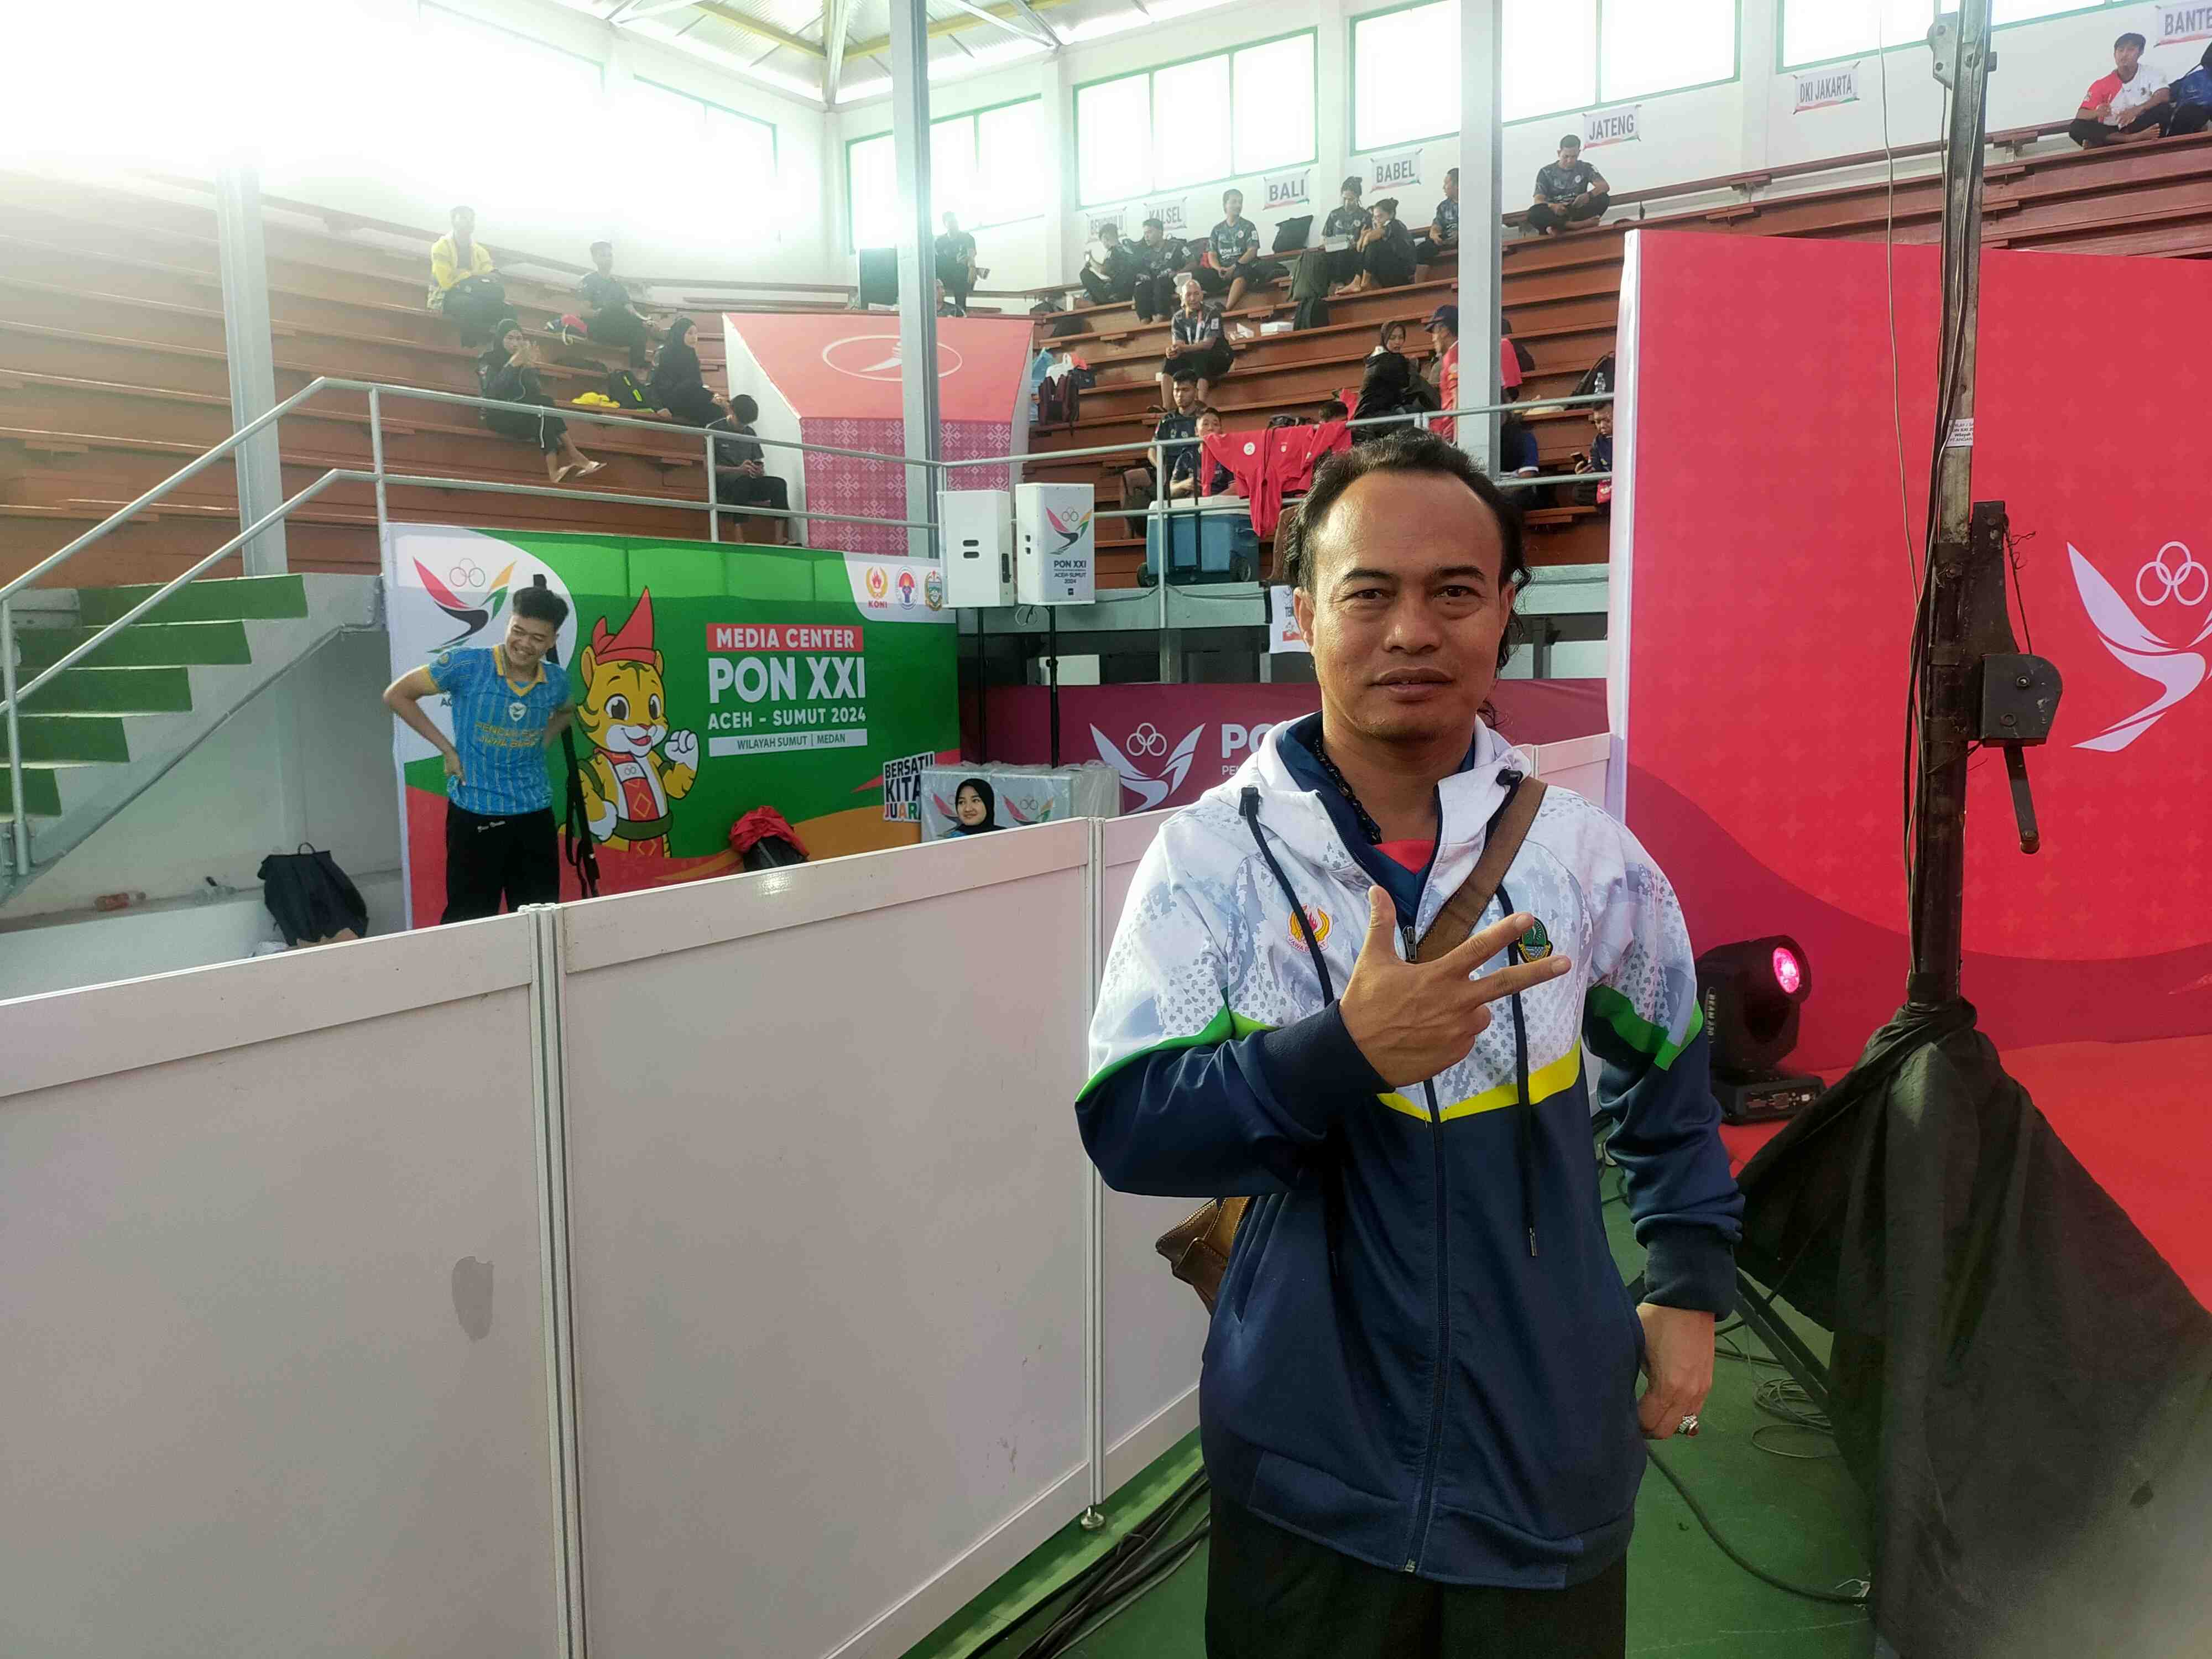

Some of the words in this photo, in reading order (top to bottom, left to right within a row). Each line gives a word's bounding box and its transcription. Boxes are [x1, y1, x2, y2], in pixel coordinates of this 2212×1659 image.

[2164, 7, 2212, 35] BANTE
[1800, 81, 1813, 103] DKI
[1815, 74, 1852, 100] JAKARTA
[1589, 114, 1635, 140] JATENG
[1376, 160, 1415, 183] BABEL
[1269, 179, 1305, 201] BALI
[868, 601, 888, 609] KONI
[716, 628, 780, 649] MEDIA
[786, 629, 855, 649] CENTER
[708, 656, 797, 704] PON
[805, 657, 866, 700] XXI
[708, 711, 753, 730] ACEH
[773, 708, 826, 726] SUMUT
[831, 707, 867, 723] 2024
[737, 738, 776, 750] WILAYAH
[778, 735, 807, 747] SUMUT
[817, 734, 846, 744] MEDAN
[1221, 723, 1275, 759] PO
[885, 774, 921, 802] KITA
[1288, 938, 1303, 951] JAWA
